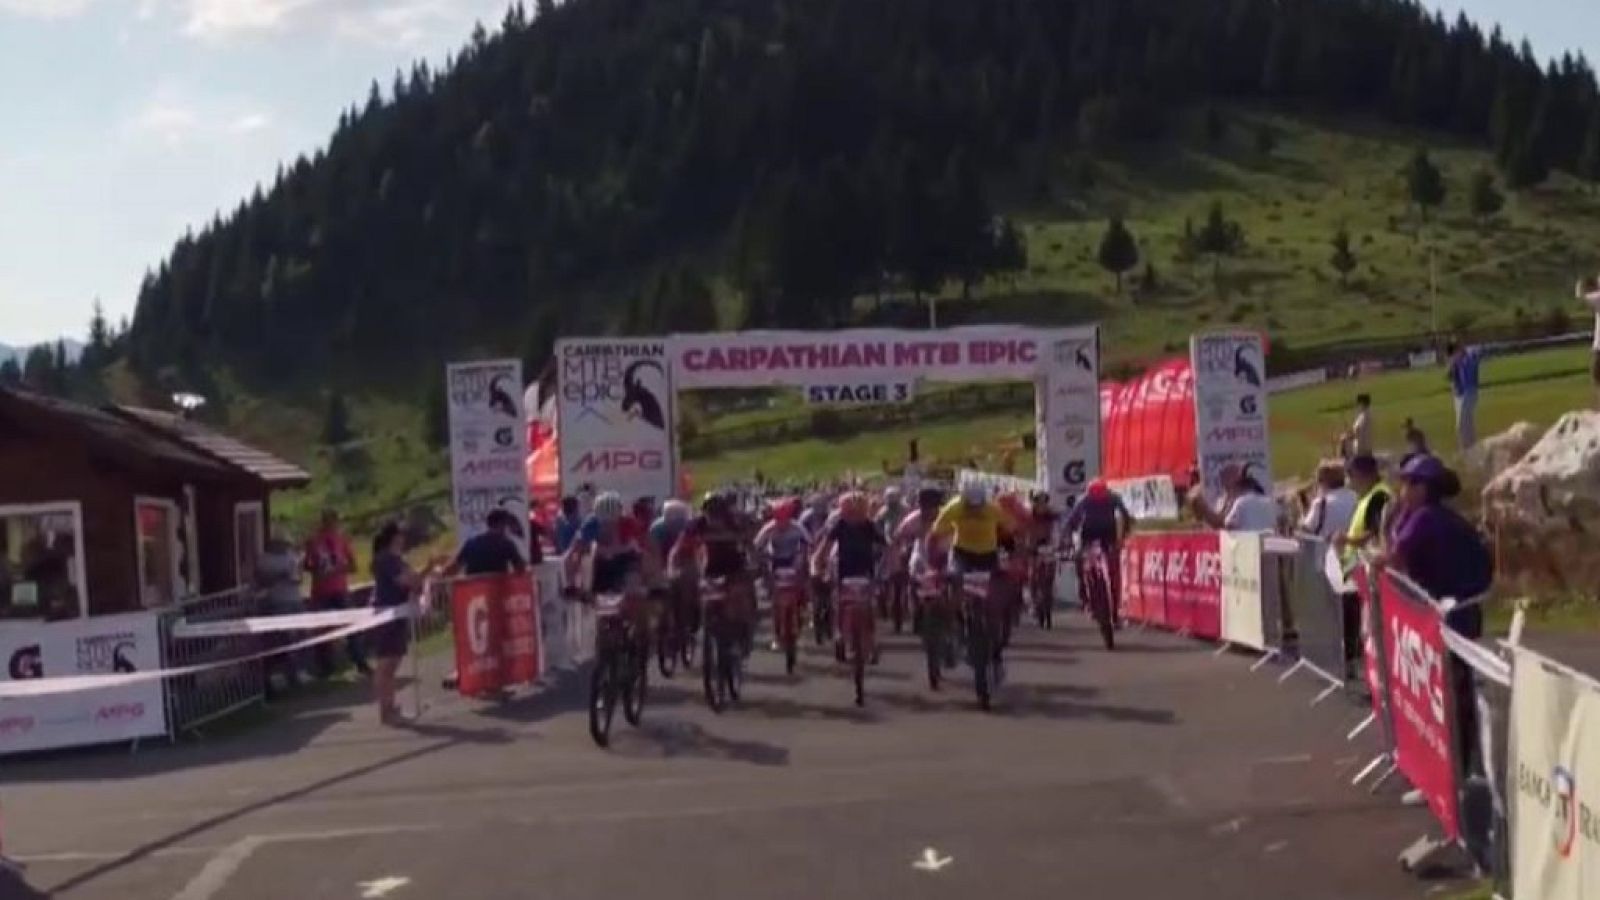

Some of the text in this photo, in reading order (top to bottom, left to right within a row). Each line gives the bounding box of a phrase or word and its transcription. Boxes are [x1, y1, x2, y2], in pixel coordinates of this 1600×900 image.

[563, 343, 664, 357] CARPATHIAN
[682, 343, 887, 373] CARPATHIAN
[893, 341, 960, 367] MTB
[969, 338, 1038, 364] EPIC
[563, 357, 624, 379] MTB
[563, 380, 622, 407] epic
[808, 383, 908, 401] STAGE 3
[570, 452, 663, 473] MPG
[1063, 460, 1086, 485] G
[467, 594, 489, 655] G
[9, 642, 43, 679] G
